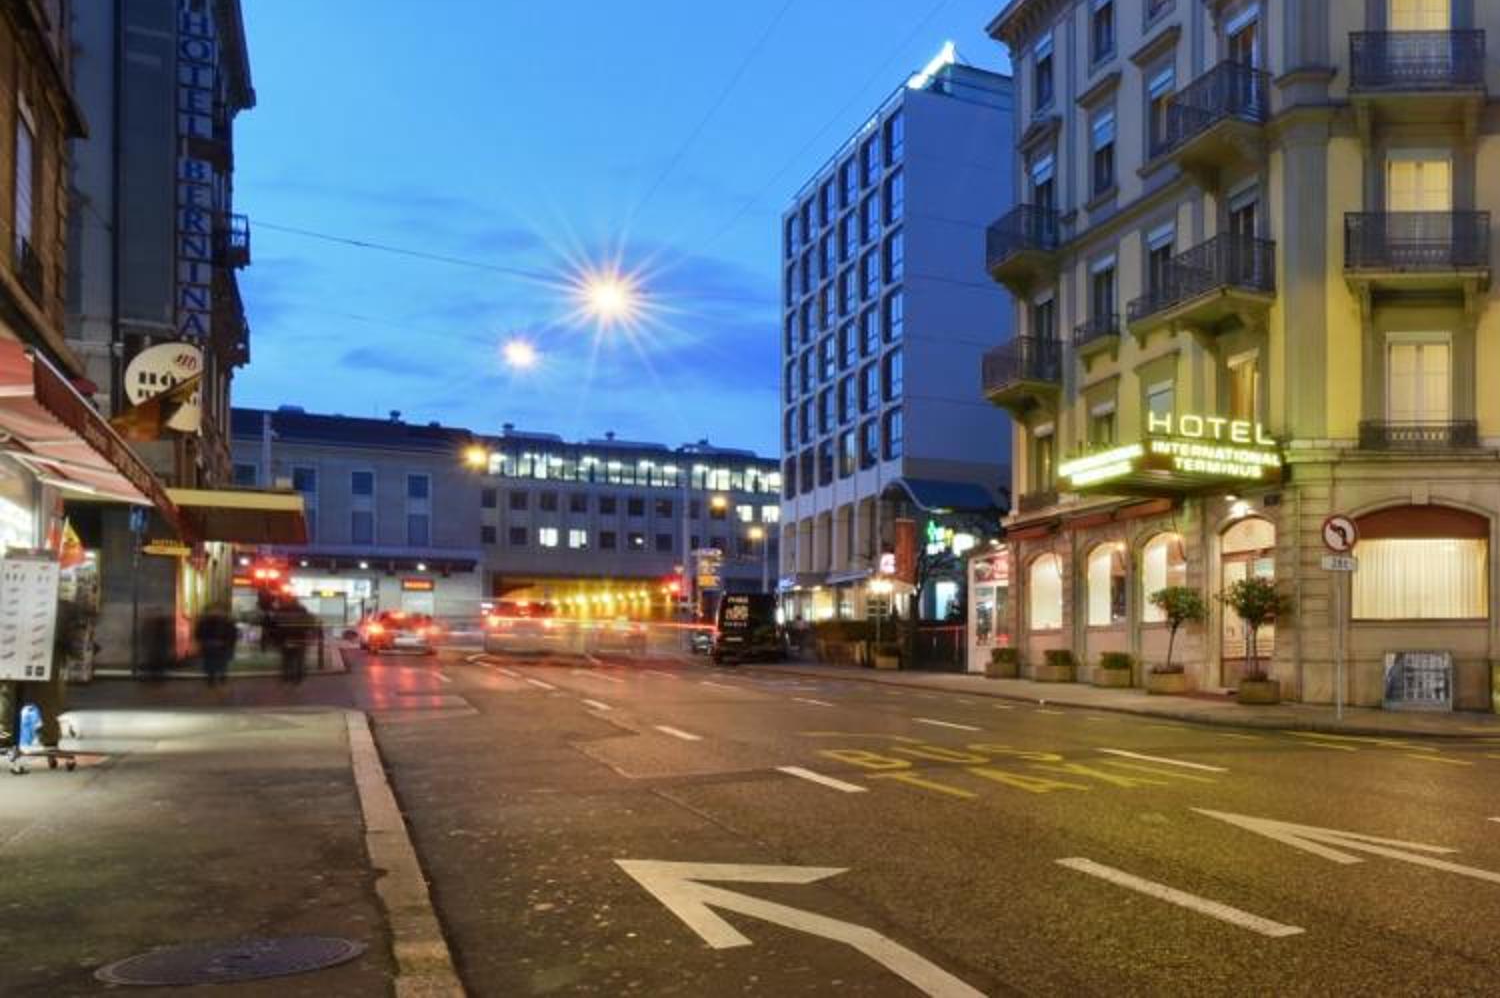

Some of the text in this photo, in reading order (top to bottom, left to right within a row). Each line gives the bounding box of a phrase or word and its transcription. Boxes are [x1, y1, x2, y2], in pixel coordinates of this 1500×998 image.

[183, 11, 210, 138] HOTEL
[181, 161, 208, 337] BERNINA
[1148, 410, 1277, 446] HOTEL
[1151, 439, 1282, 467] INTERNATIONAL
[1173, 456, 1264, 480] TERMINUS
[814, 742, 1065, 771] BUS
